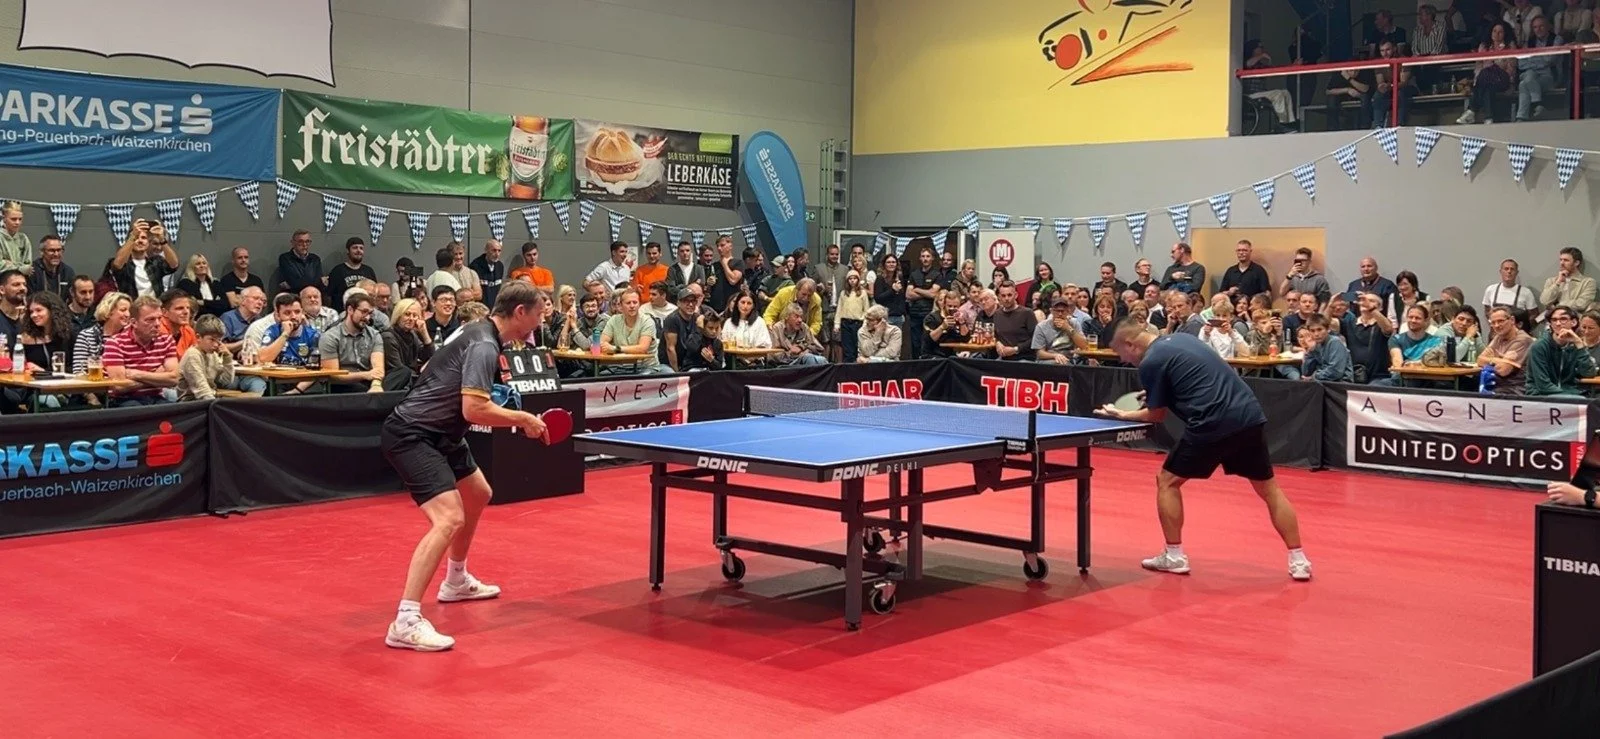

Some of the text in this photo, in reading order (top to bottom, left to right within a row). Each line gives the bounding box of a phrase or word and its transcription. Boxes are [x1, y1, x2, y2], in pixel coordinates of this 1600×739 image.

[0, 90, 174, 134] ARKASSE
[292, 107, 493, 175] Freistädter
[667, 163, 732, 186] LEBERKÄSE
[513, 355, 525, 374] 0
[532, 354, 543, 373] 0
[507, 379, 557, 393] TIBHAR
[1361, 396, 1562, 425] AIGNER
[1116, 429, 1147, 443] DONIC
[697, 455, 749, 473] DONIC
[832, 461, 918, 481] DONIC DELHI
